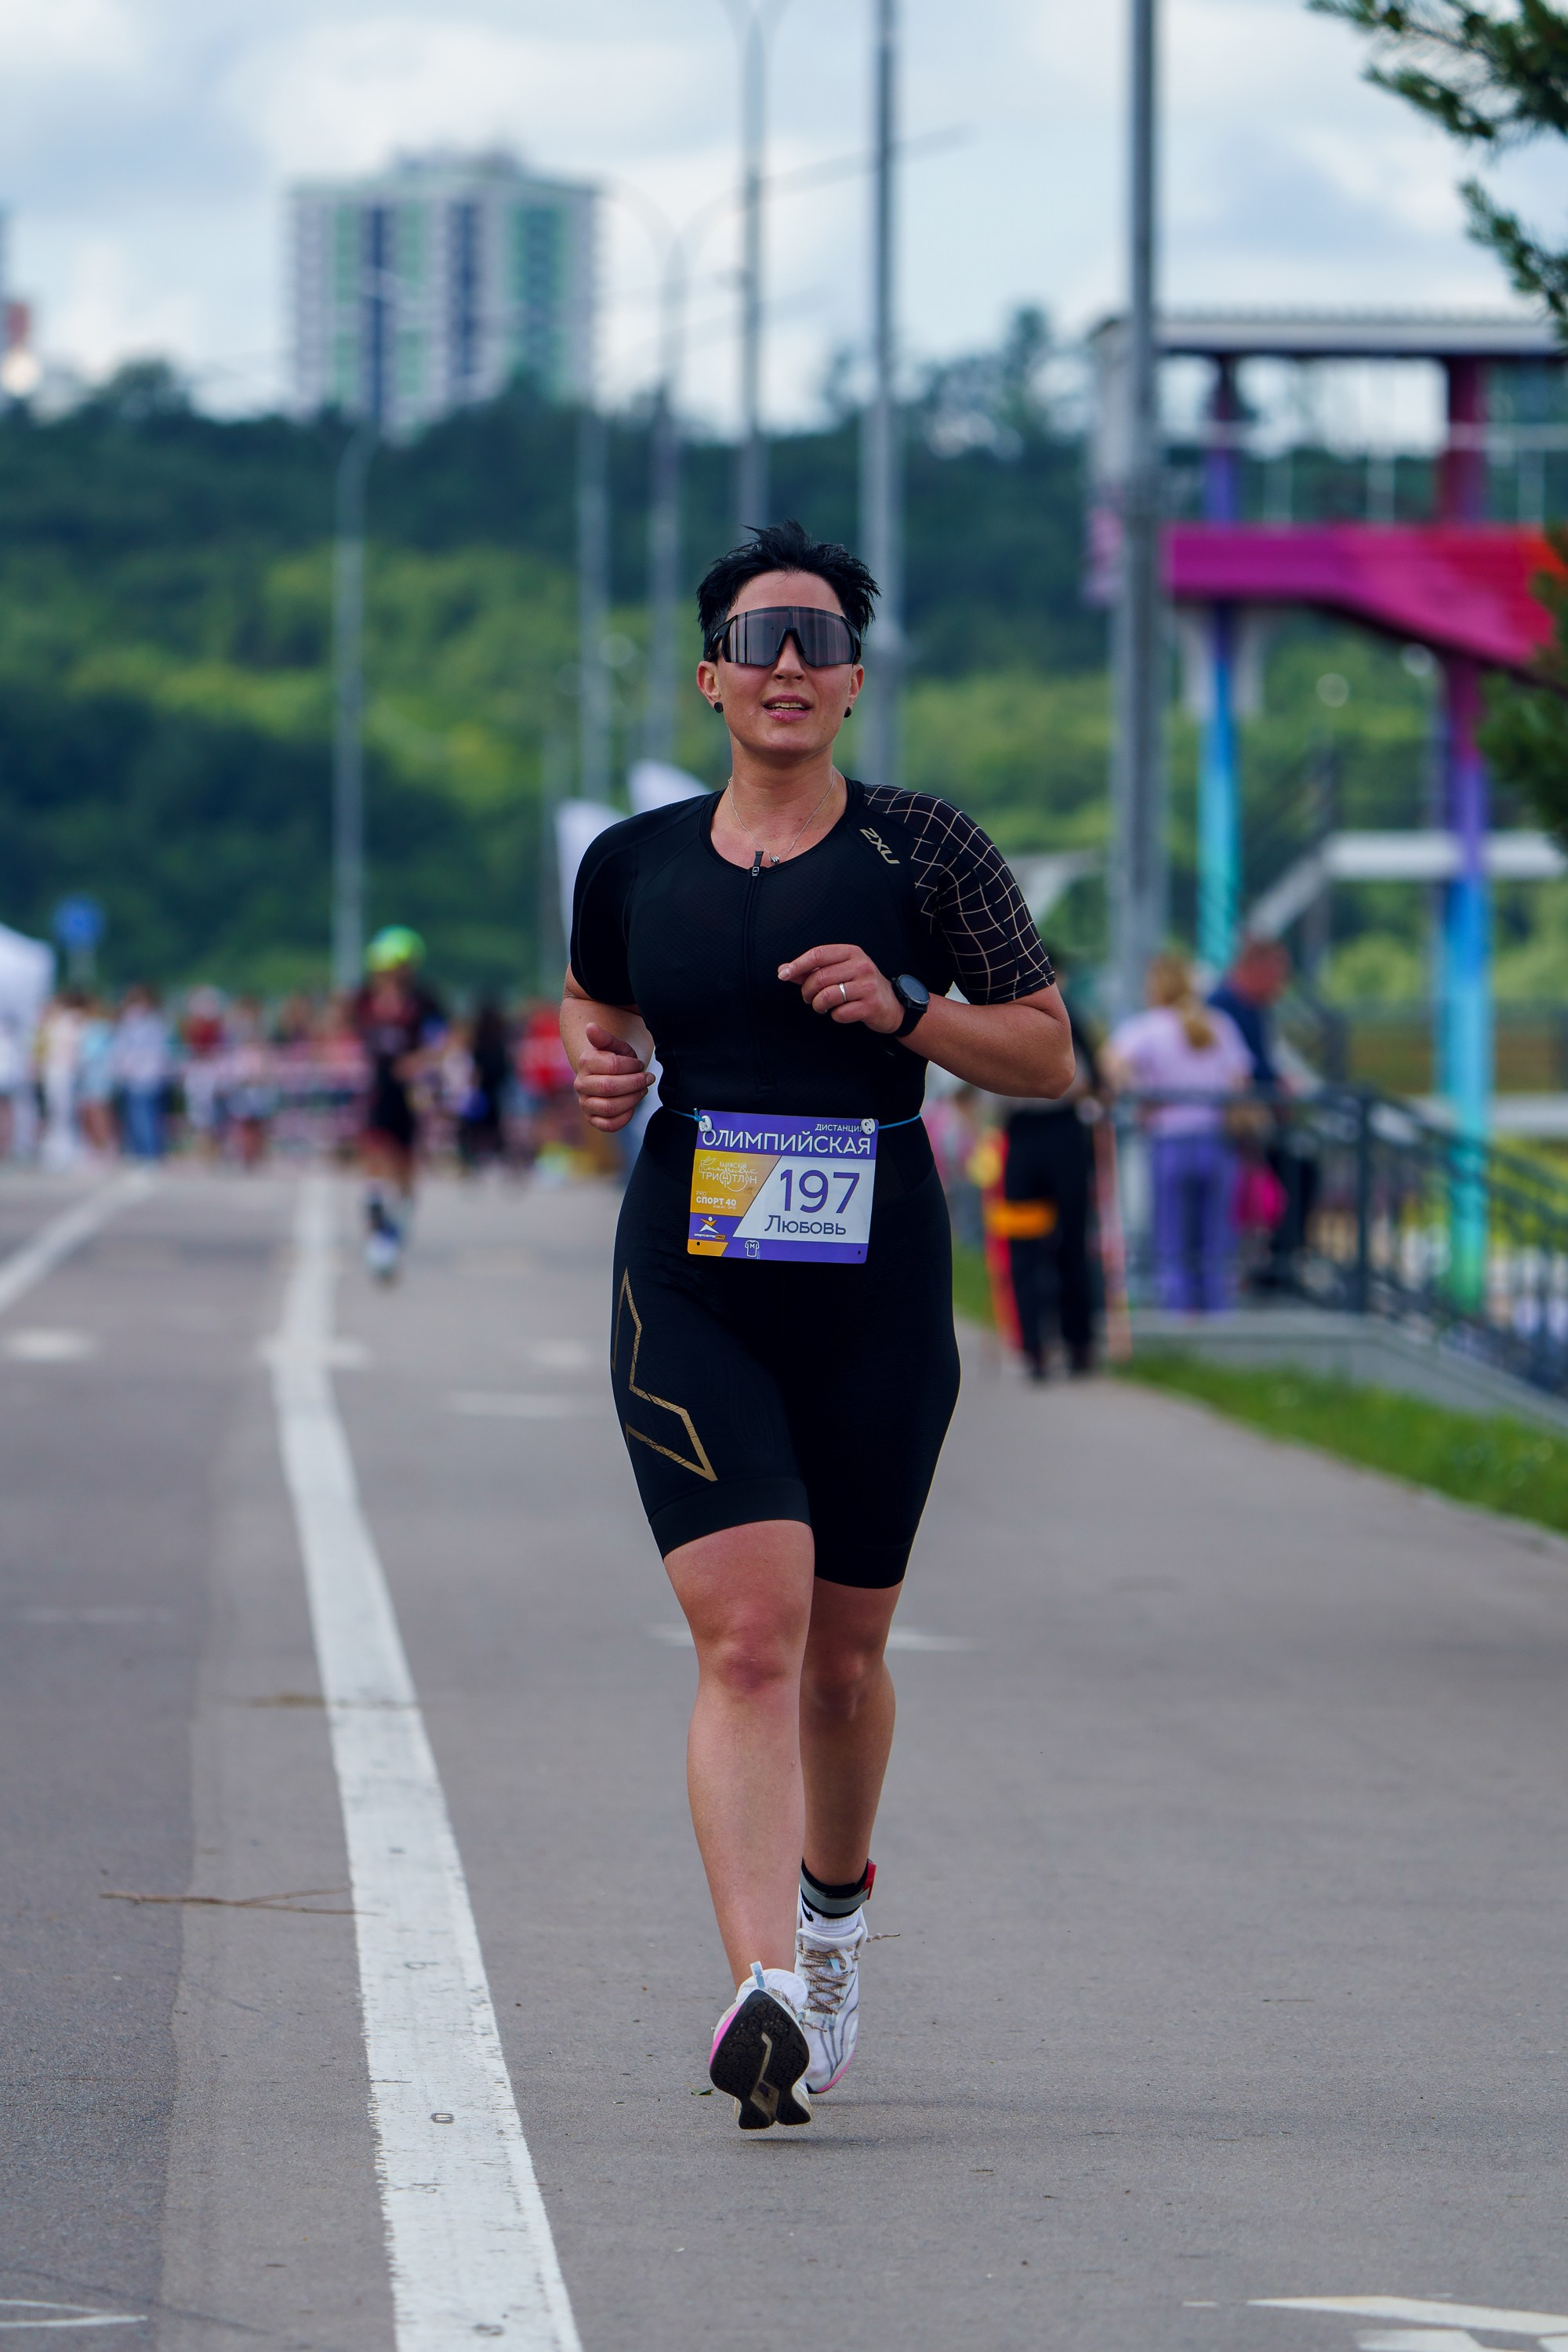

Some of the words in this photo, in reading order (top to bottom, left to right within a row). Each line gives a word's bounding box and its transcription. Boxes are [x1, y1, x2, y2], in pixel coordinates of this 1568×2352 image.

[859, 828, 900, 864] 2XU
[702, 1129, 871, 1155] ОЛИМПИЙСКАЯ
[696, 1196, 724, 1206] СПОРТ
[779, 1169, 860, 1214] 197
